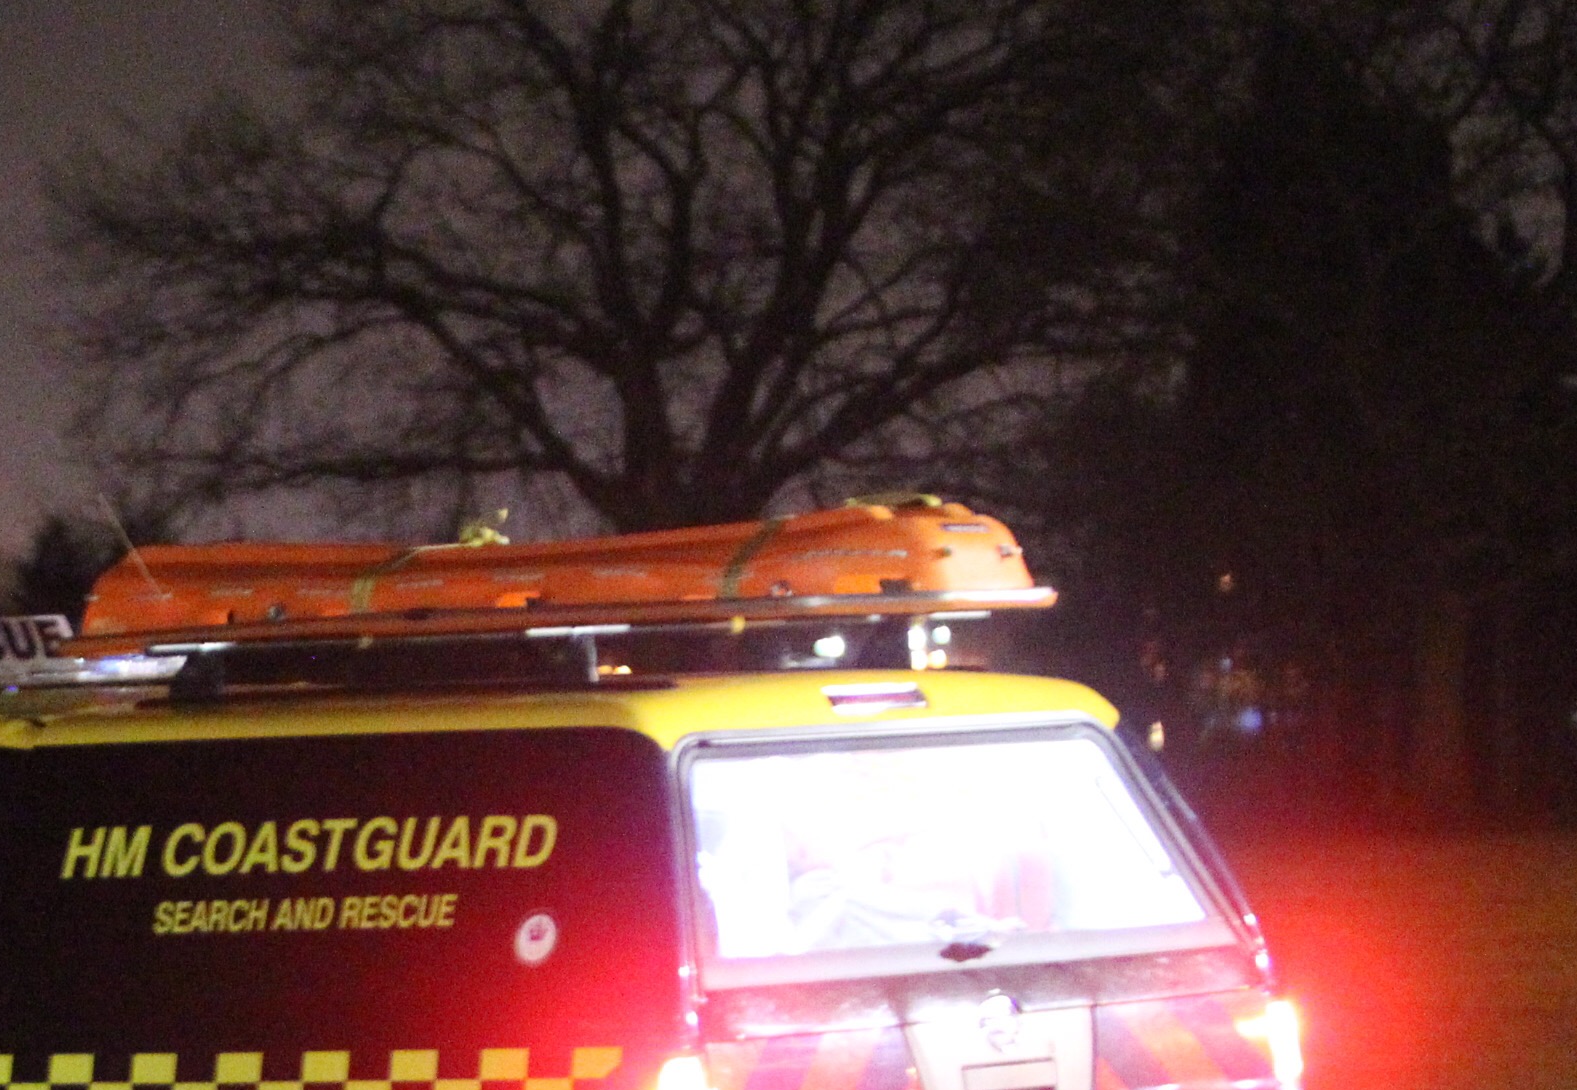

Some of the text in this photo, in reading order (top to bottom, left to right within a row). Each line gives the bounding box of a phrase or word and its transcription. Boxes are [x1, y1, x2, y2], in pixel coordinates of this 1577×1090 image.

[60, 813, 558, 879] HM COASTGUARD
[152, 894, 459, 935] SEARCH AND RESCUE
